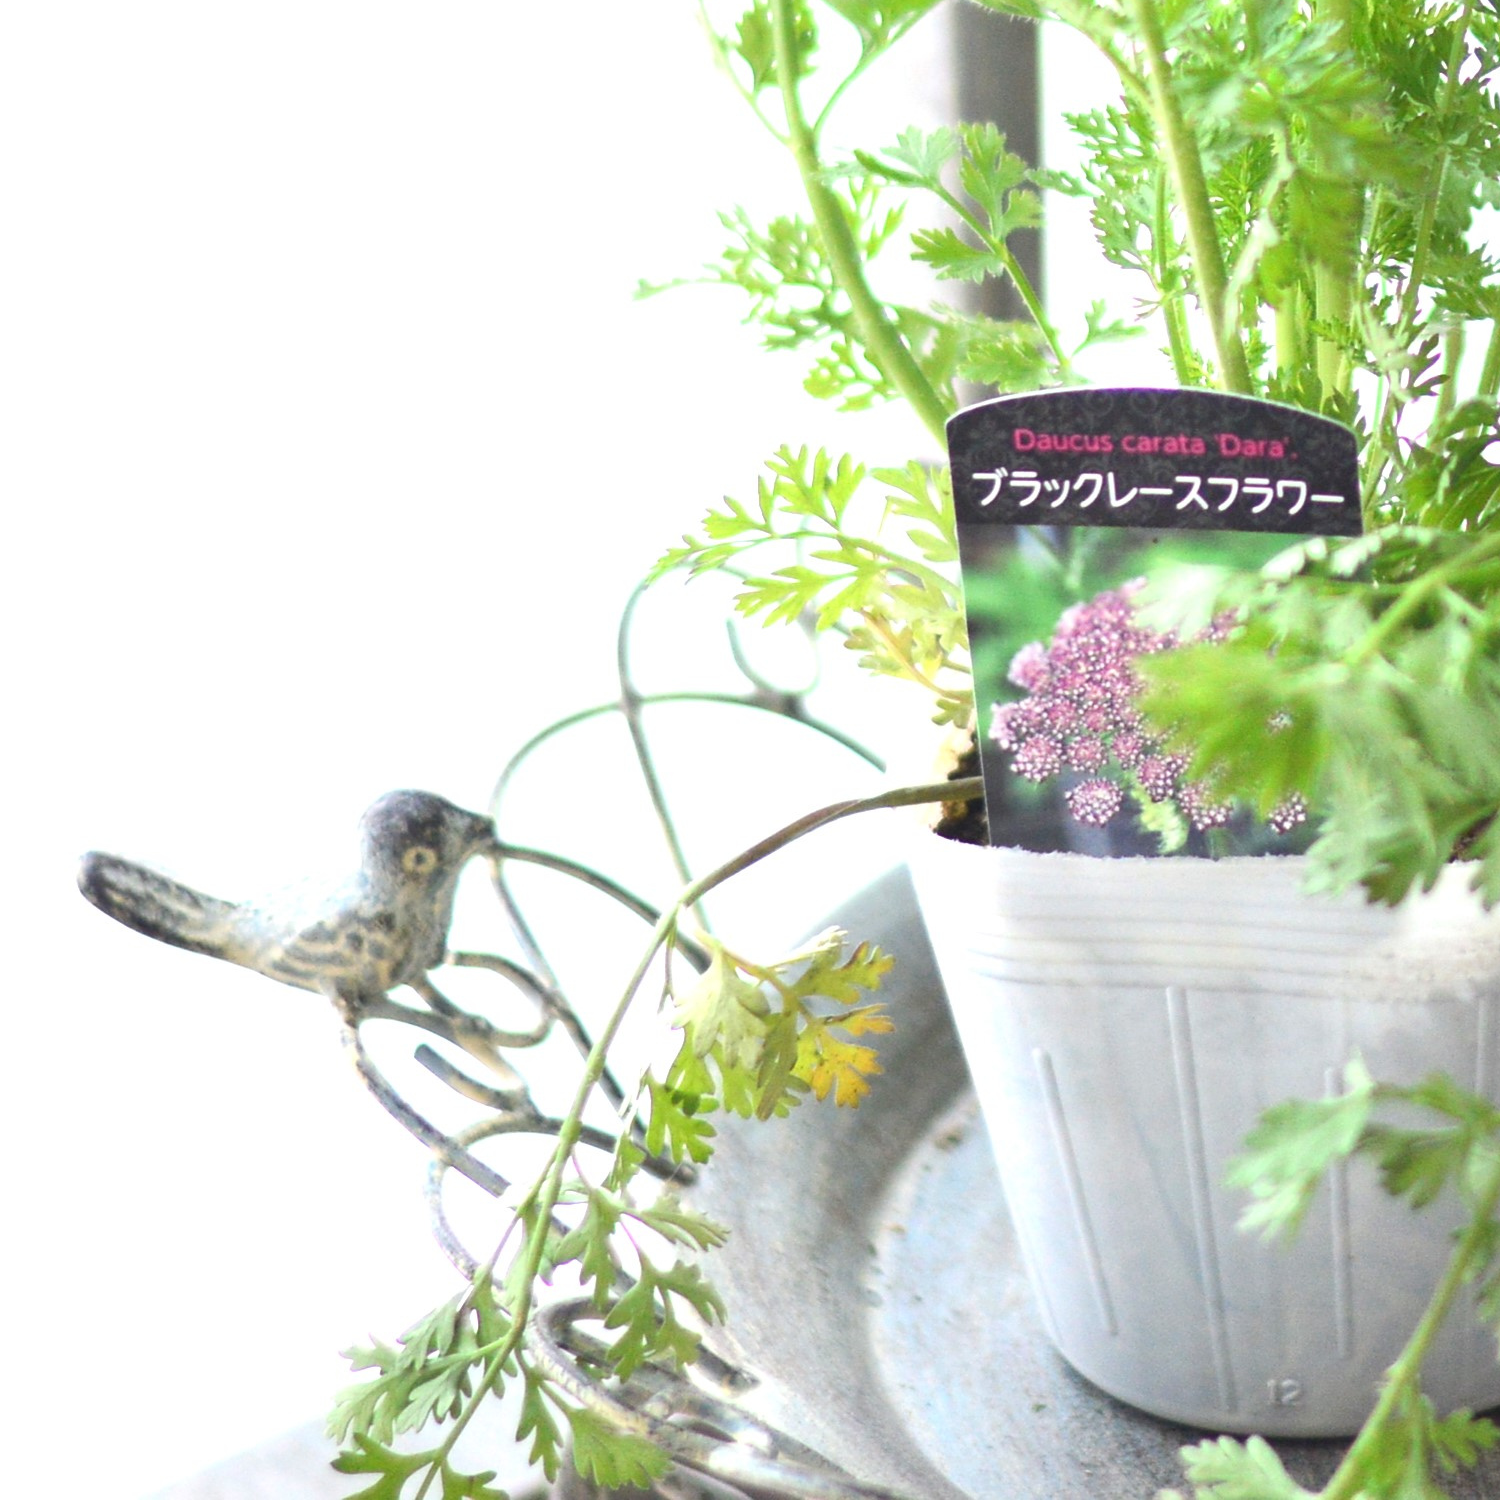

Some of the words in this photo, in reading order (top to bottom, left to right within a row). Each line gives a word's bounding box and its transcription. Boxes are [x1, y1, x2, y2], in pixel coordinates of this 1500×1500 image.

[1013, 427, 1114, 452] Daucus
[1121, 432, 1207, 456] carata
[972, 466, 1346, 516] ブラックレースフラワー
[1266, 1378, 1302, 1406] 12
